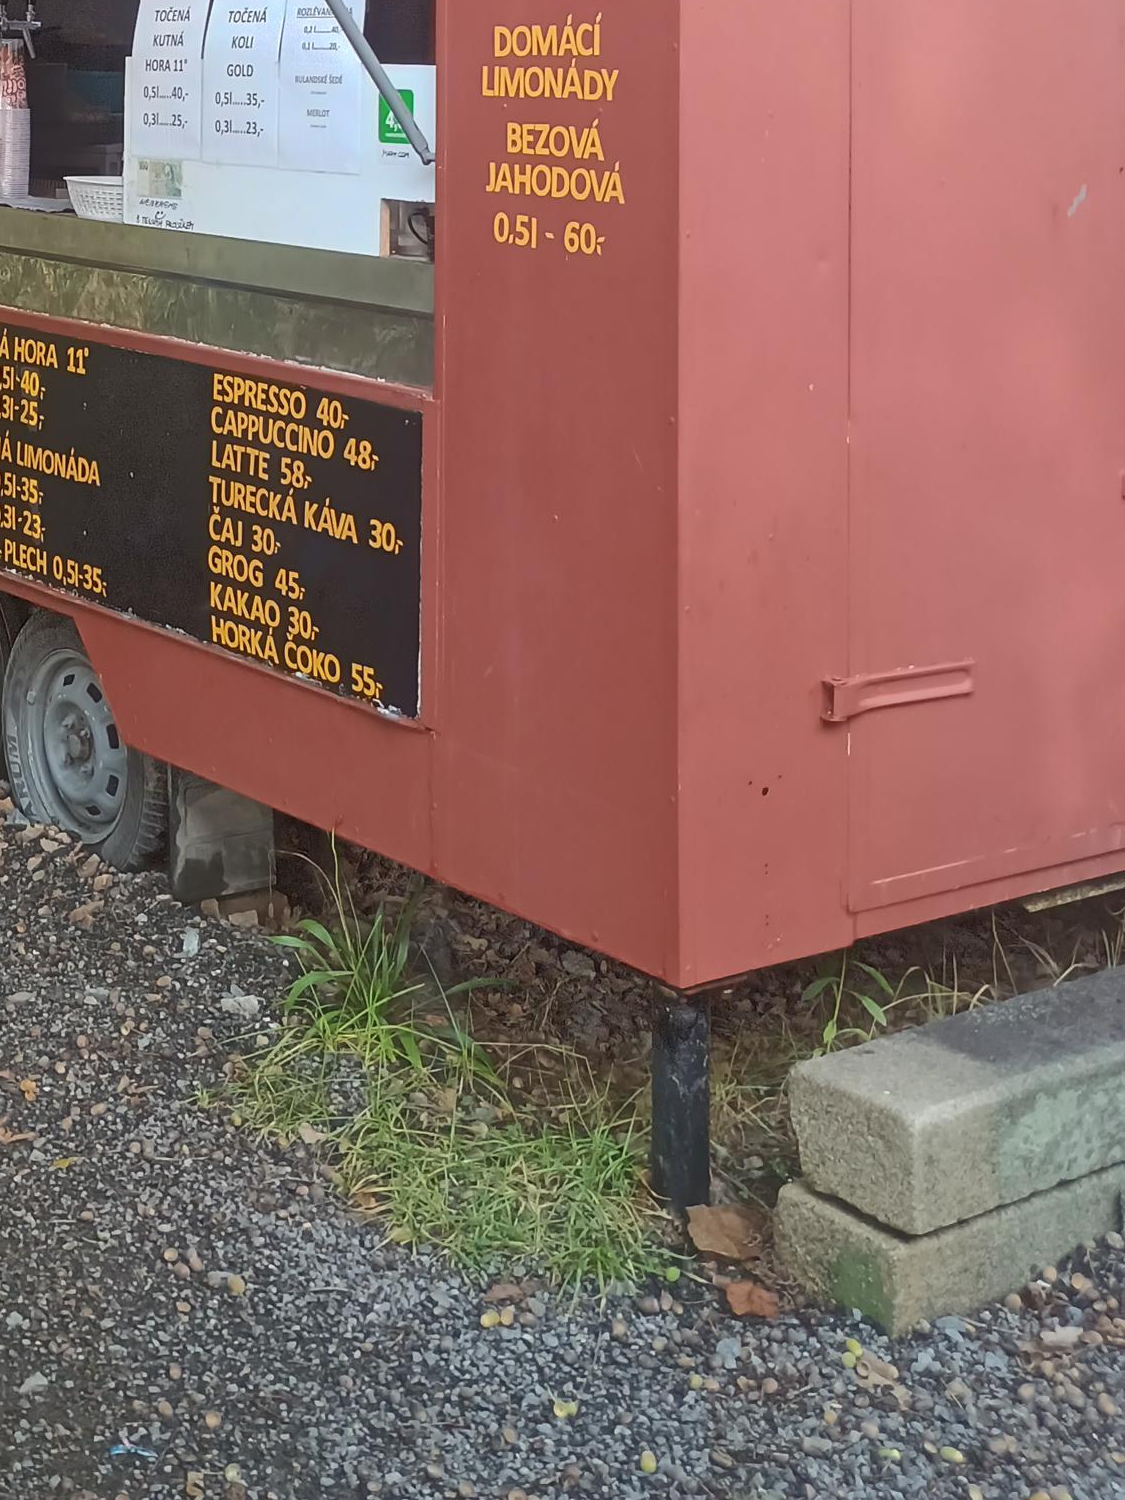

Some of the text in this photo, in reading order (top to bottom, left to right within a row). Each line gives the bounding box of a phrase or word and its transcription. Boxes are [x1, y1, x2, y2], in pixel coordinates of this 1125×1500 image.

[155, 6, 191, 22] TOČENÁ
[228, 6, 268, 23] TOČENÁ
[494, 12, 602, 57] DOMÁCÍ
[153, 31, 184, 47] KUTNÁ
[231, 35, 254, 49] KOLI
[145, 59, 171, 72] HORA
[226, 63, 254, 77] GOLD
[482, 58, 619, 101] LIMONÁDY
[307, 109, 330, 117] MERLOT
[506, 118, 604, 161] BEZOVÁ
[486, 161, 625, 204] JAHODOVÁ
[14, 339, 58, 368] HORA
[213, 372, 306, 420] ESPRESSO
[211, 405, 334, 460] CAPPUCCINO
[17, 441, 101, 487] LIMONÁDA
[211, 440, 270, 480] LATTE
[208, 506, 243, 548] ČAJ
[209, 475, 297, 526] TURECKÁ
[304, 496, 358, 544] KÁVA
[4, 538, 48, 576] PLECH
[208, 545, 264, 588] GROG
[210, 581, 280, 628] KAKAO
[211, 615, 279, 665] HORKÁ
[284, 632, 341, 684] ČOKO
